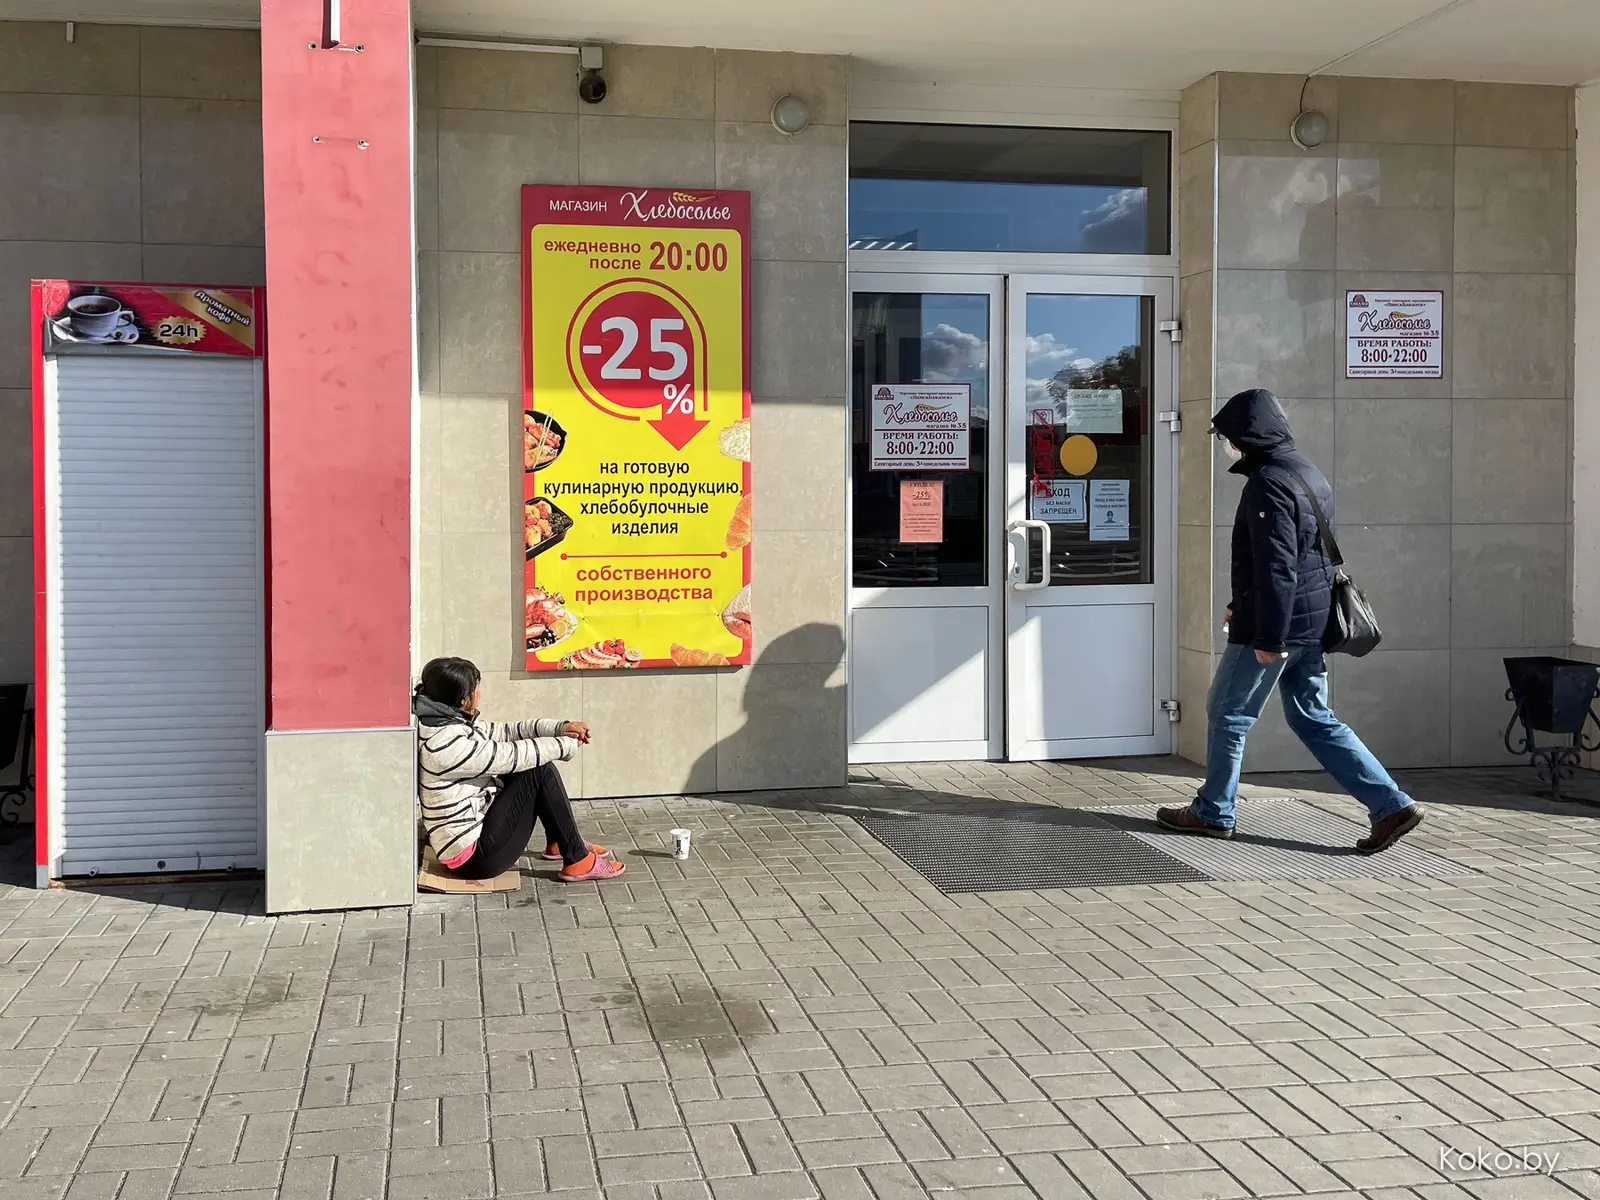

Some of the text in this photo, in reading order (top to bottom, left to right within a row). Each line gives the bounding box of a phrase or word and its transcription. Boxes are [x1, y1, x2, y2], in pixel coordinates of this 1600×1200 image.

[549, 190, 731, 221] МАГАЗИН Хлебосолье
[544, 240, 641, 254] ежедневно
[589, 257, 641, 270] после
[649, 241, 728, 271] 20:00
[195, 290, 251, 326] Ароматный
[206, 305, 232, 325] кофе
[1358, 309, 1431, 333] Хлебосолье
[159, 324, 198, 338] 24h
[883, 402, 958, 425] Хлебосолье
[883, 432, 959, 440] ВРЕМЯ РАБОТЫ:
[600, 462, 690, 478] на готовую
[544, 481, 743, 498] кулинарную продукцию,
[580, 499, 709, 518] хлебобулочные
[1040, 507, 1077, 515] ЗАПРЕЩЕН
[611, 522, 679, 536] изделия
[576, 565, 712, 582] собственного
[575, 587, 713, 605] производства
